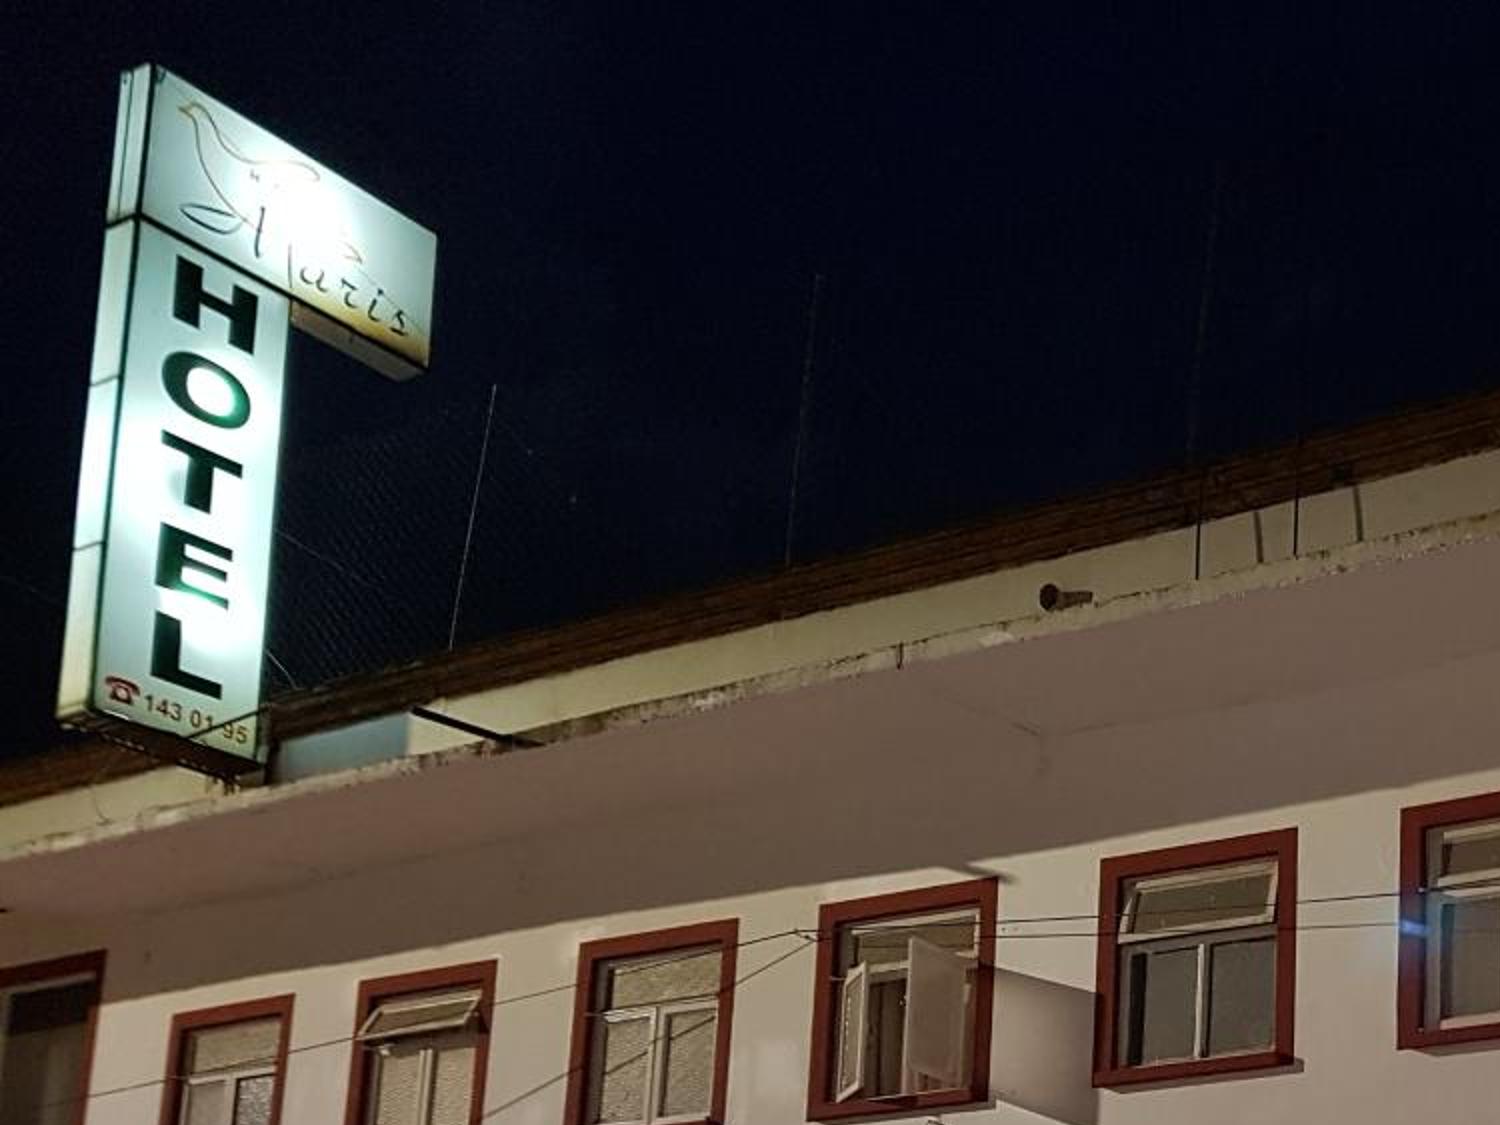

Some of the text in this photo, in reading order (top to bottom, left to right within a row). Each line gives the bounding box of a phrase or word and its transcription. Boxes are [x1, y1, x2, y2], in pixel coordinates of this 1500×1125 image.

[151, 255, 259, 700] HOTEL
[144, 694, 248, 745] 143 01 95
